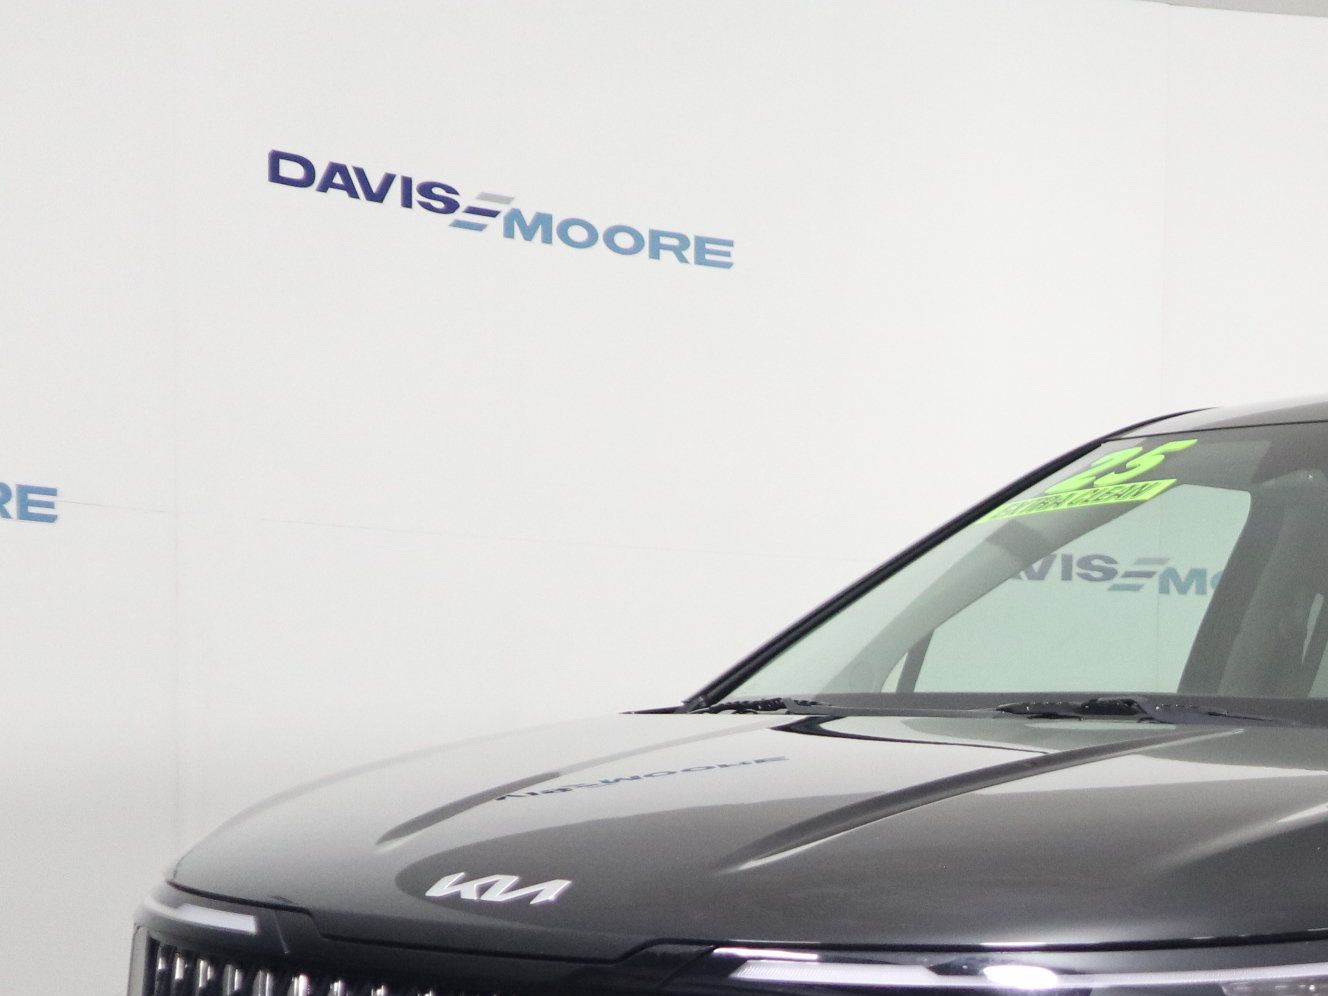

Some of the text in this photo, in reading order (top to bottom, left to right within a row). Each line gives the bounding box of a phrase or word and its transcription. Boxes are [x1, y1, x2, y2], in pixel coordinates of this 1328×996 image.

[267, 148, 735, 270] DAVIS MOORE
[0, 481, 58, 523] E
[1010, 553, 1119, 582] VIS
[425, 872, 572, 905] KIA
